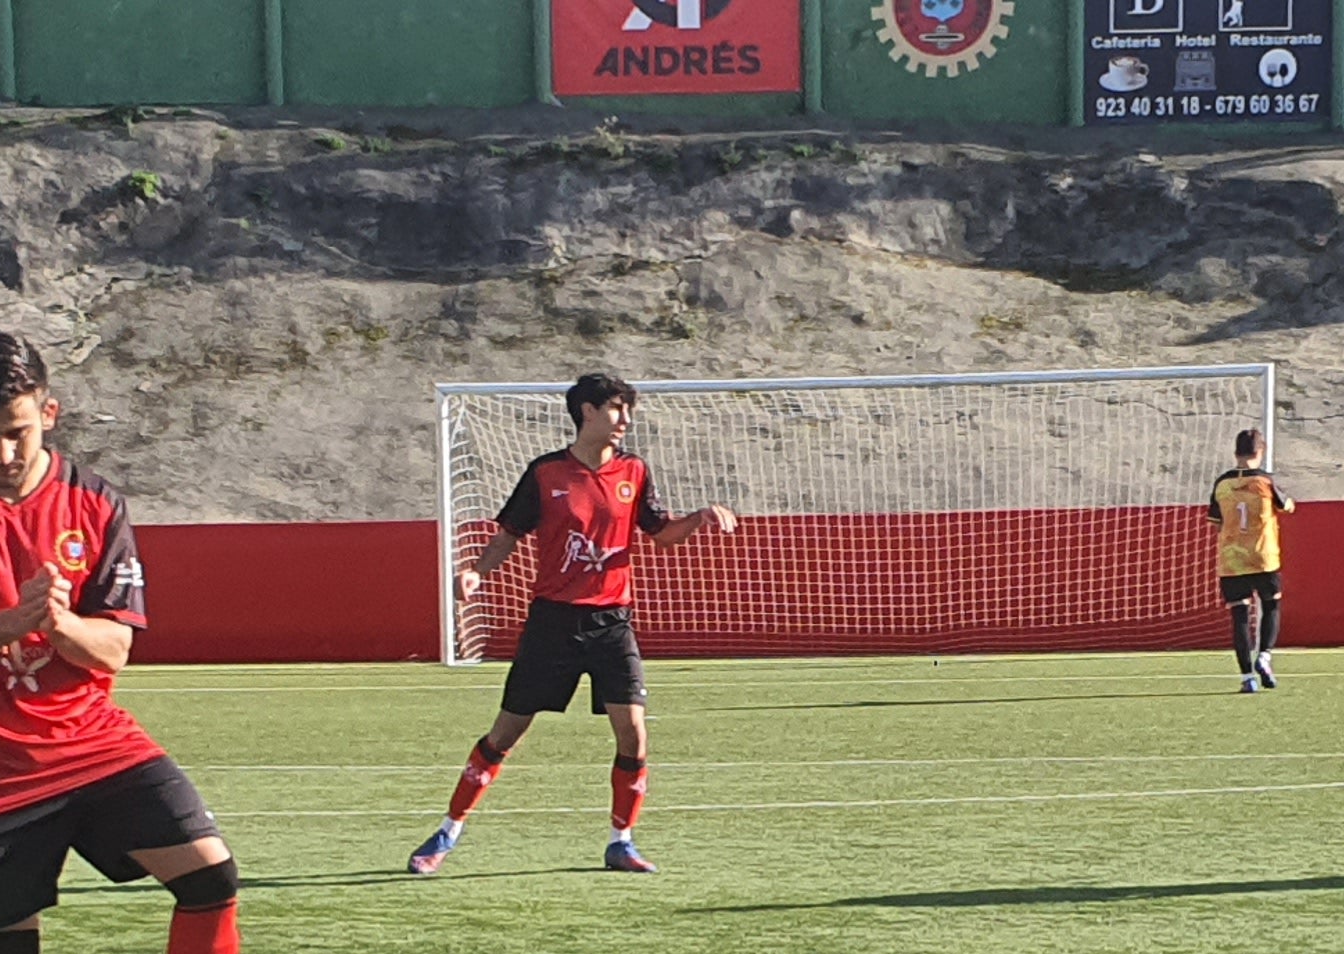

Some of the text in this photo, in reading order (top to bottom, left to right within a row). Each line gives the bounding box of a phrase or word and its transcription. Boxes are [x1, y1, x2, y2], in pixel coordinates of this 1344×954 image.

[1175, 35, 1216, 47] Hotel
[1230, 33, 1323, 46] Restaurante
[593, 41, 761, 77] ANDRÉS
[1096, 97, 1126, 116] 923
[1130, 97, 1151, 116] 40
[1155, 96, 1174, 115] 31
[1182, 96, 1200, 115] 18
[1215, 95, 1245, 114] 679
[1249, 95, 1270, 114] 60
[1274, 94, 1294, 113] 36
[1299, 94, 1320, 113] 67
[1236, 501, 1249, 533] 1
